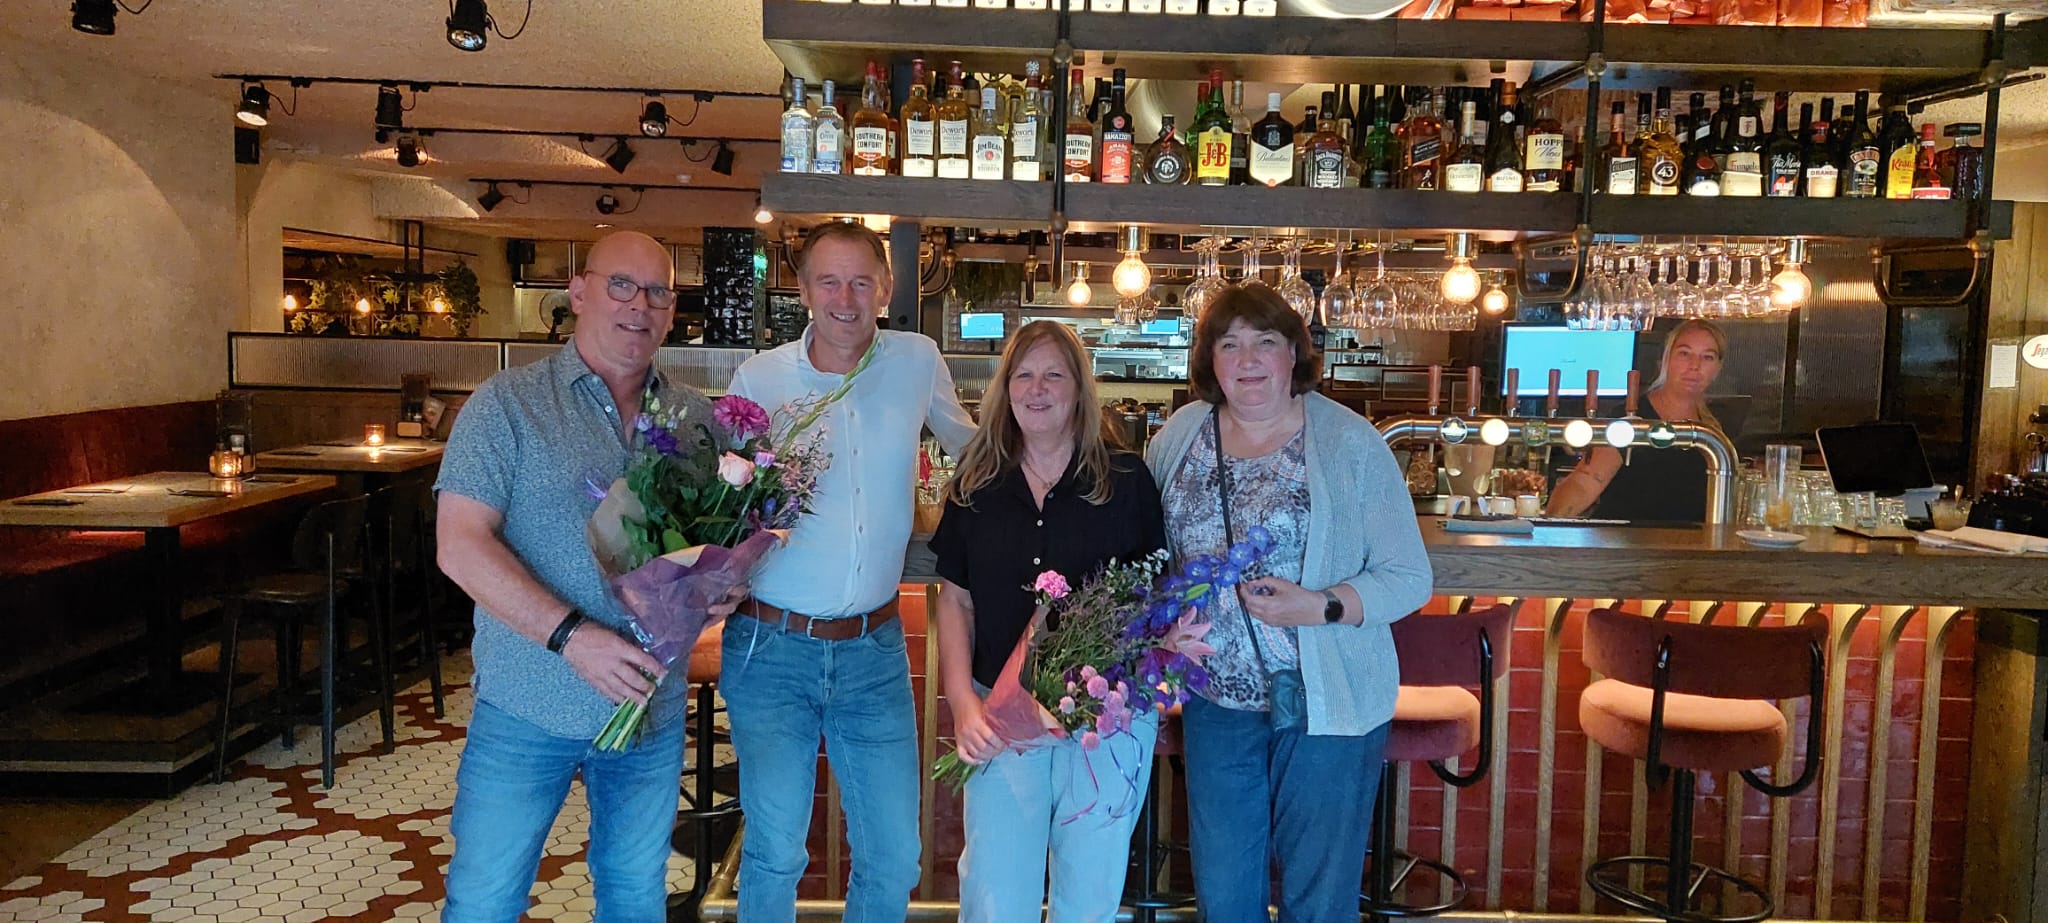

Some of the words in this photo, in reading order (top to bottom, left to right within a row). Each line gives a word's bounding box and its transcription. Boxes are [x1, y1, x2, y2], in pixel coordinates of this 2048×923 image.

[856, 132, 884, 141] SOUTHERN
[857, 141, 883, 149] COMFORT
[1066, 139, 1091, 148] OUTHERN
[1067, 147, 1089, 156] OMFORT
[1201, 142, 1227, 167] J&B
[1657, 165, 1674, 178] 43
